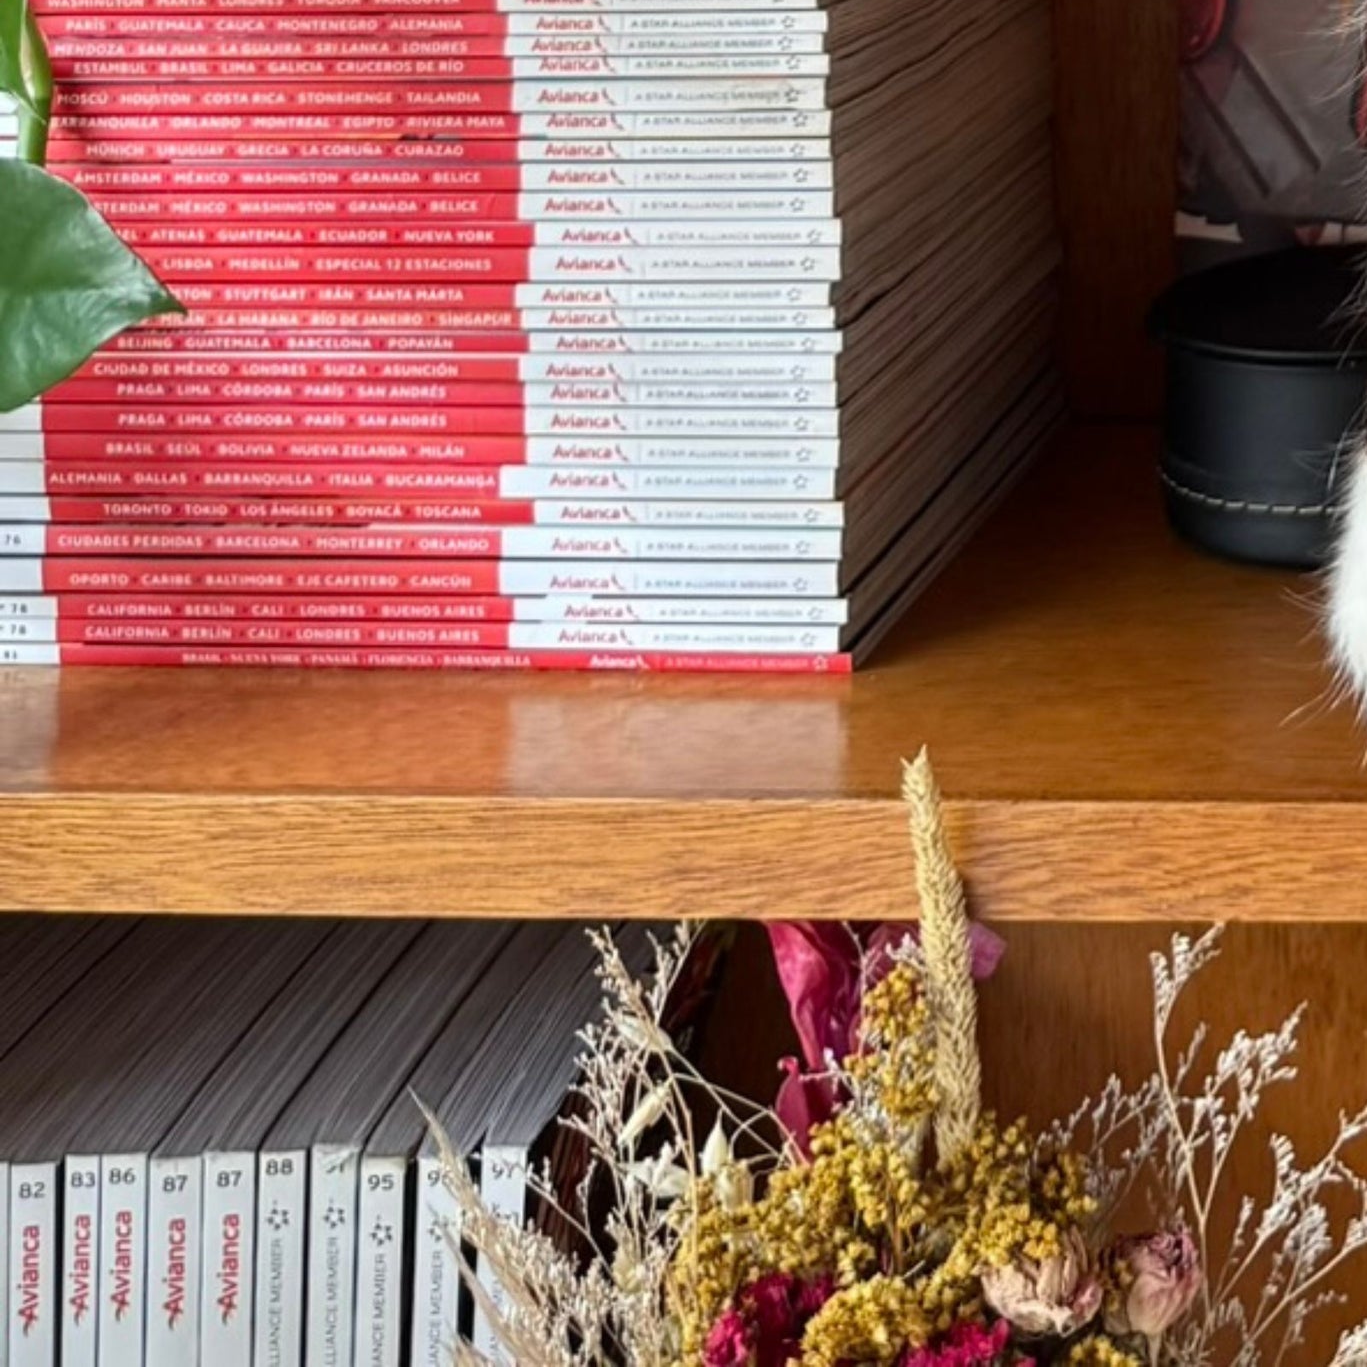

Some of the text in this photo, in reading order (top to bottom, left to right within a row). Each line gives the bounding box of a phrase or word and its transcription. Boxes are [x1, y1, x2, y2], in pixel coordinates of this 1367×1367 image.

[87, 601, 623, 618] CALIFORNIA BERLÍN CALI LONDRES BUENOS AIRES Avianca
[265, 1159, 293, 1175] 88
[71, 1172, 96, 1188] 83
[108, 1168, 136, 1185] 86
[162, 1175, 188, 1193] 87
[217, 1170, 242, 1187] 87
[367, 1175, 394, 1191] 95
[19, 1182, 46, 1198] 82
[69, 1214, 91, 1313] Avianca
[110, 1211, 132, 1308] Avianca
[216, 1214, 240, 1313] Avianca
[17, 1224, 40, 1322] Avianca
[162, 1218, 186, 1319] Avianca
